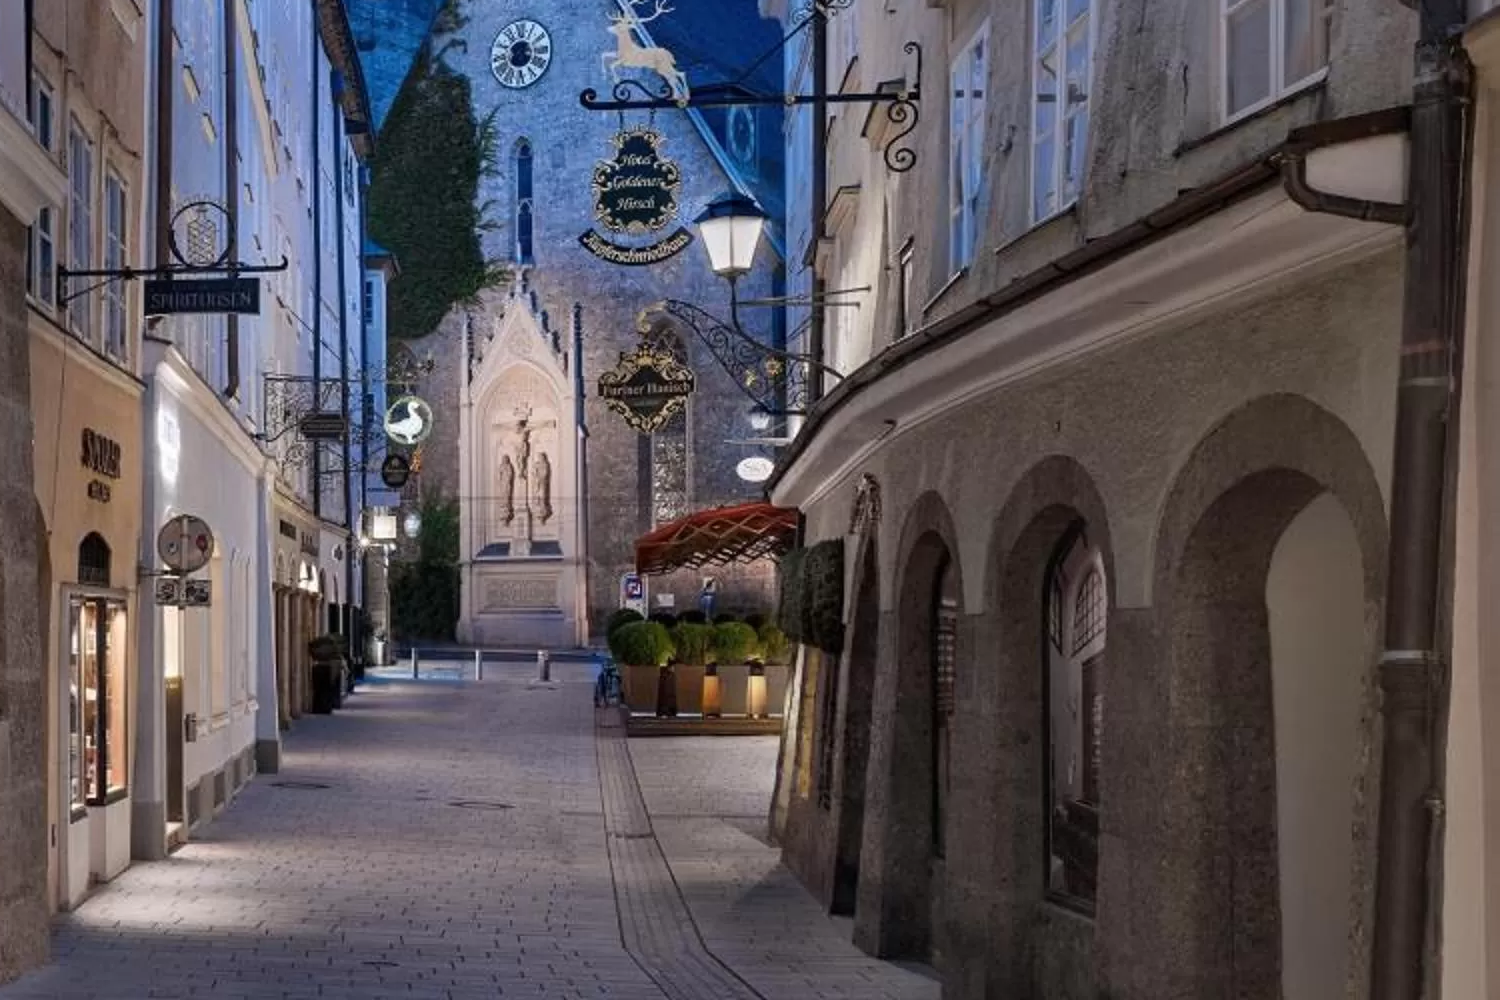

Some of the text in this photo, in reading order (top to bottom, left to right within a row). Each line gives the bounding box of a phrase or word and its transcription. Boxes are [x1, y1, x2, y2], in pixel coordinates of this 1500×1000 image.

[619, 153, 655, 167] Hotel
[613, 175, 664, 190] Goldener
[616, 195, 656, 211] Hirsch
